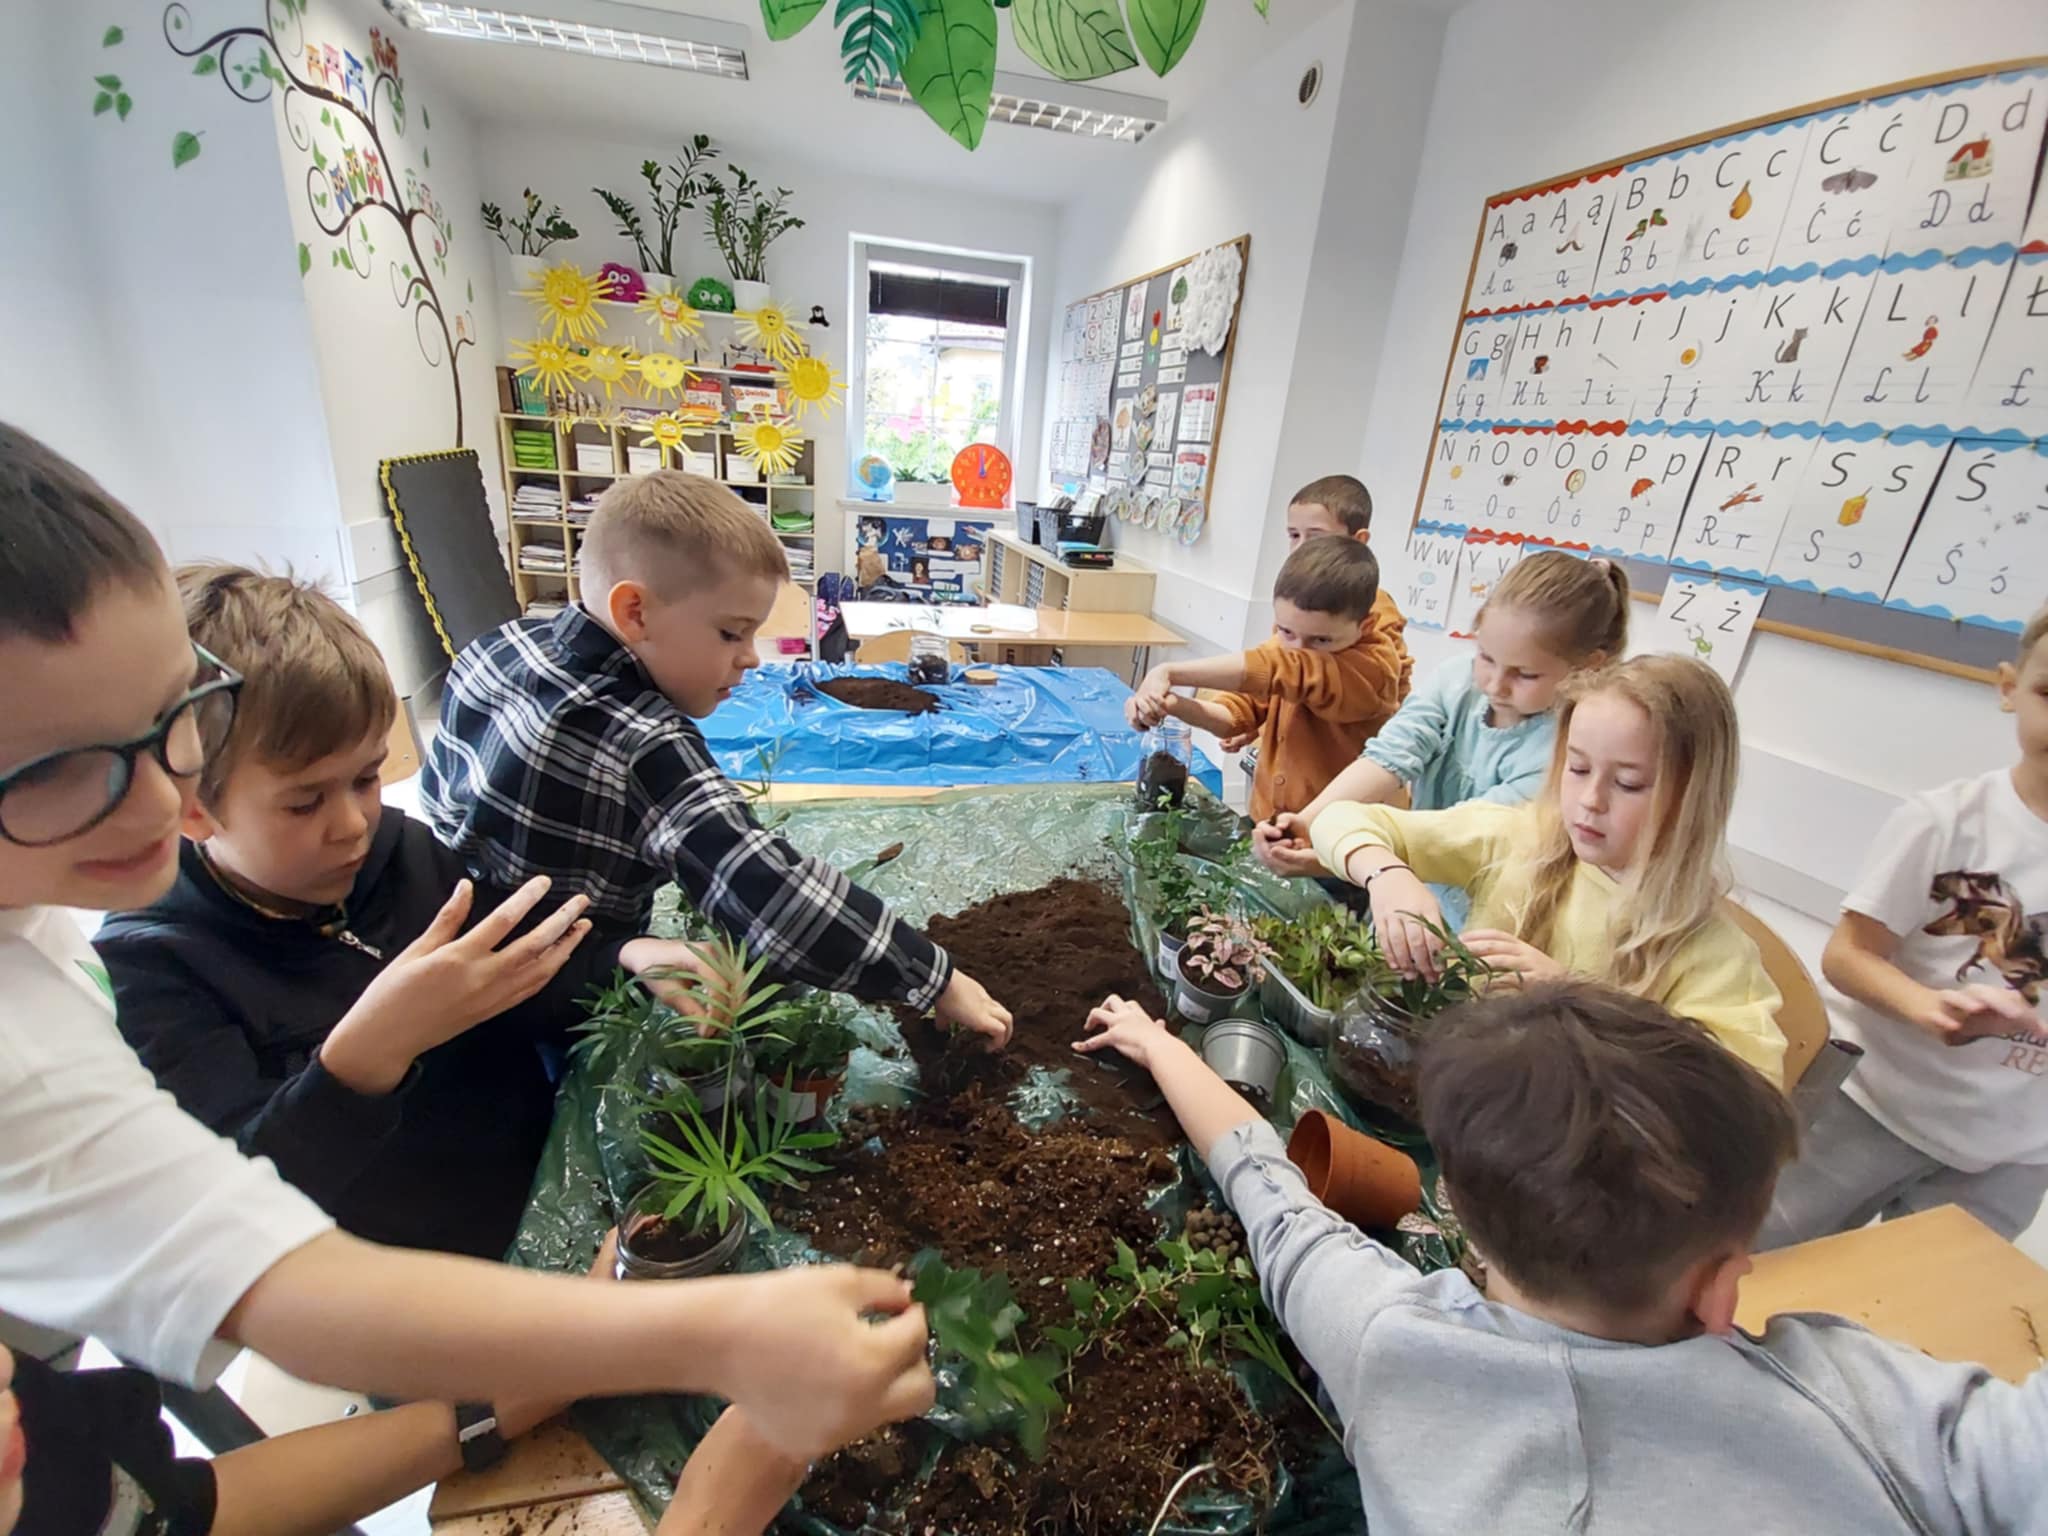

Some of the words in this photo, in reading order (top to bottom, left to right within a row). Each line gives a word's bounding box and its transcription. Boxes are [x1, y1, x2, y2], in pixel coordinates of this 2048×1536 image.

[1935, 103, 1968, 144] D
[2002, 88, 2032, 131] d
[1820, 116, 1849, 164] Ć
[1879, 113, 1902, 152] ć
[1716, 152, 1741, 188] C
[1626, 177, 1647, 210] B
[1669, 166, 1689, 200] b
[1920, 189, 1951, 229] D
[1968, 182, 1994, 223] d
[1490, 214, 1504, 241] A
[1522, 213, 1535, 233] a
[1807, 201, 1826, 243] Ć
[1846, 210, 1862, 237] ć
[1615, 245, 1632, 274] B
[1647, 240, 1657, 269] b
[1703, 228, 1720, 260] C
[1763, 293, 1796, 329] K
[1888, 283, 1907, 321] L
[1521, 323, 1541, 350] H
[1556, 319, 1572, 347] h
[1633, 310, 1645, 341] i
[1668, 306, 1687, 341] J
[1714, 299, 1737, 343] j
[1464, 330, 1480, 355] G
[1490, 333, 1507, 360] g
[1534, 381, 1548, 406] h
[1684, 380, 1702, 417] j
[1745, 370, 1775, 403] K
[1440, 433, 1456, 461] Ń
[1467, 439, 1481, 462] ń
[1555, 436, 1575, 469] Ó
[1591, 443, 1609, 471] ó
[1625, 444, 1647, 472] P
[1661, 453, 1686, 484] p
[1715, 446, 1741, 478] R
[1771, 457, 1792, 481] r
[1821, 452, 1856, 487] S
[1956, 453, 1996, 502] Ś
[1640, 523, 1655, 550] p
[1696, 515, 1719, 546] R
[1413, 540, 1433, 562] W
[1469, 551, 1482, 572] Y
[1937, 542, 1964, 585] Ś
[1670, 583, 1696, 622] Ż
